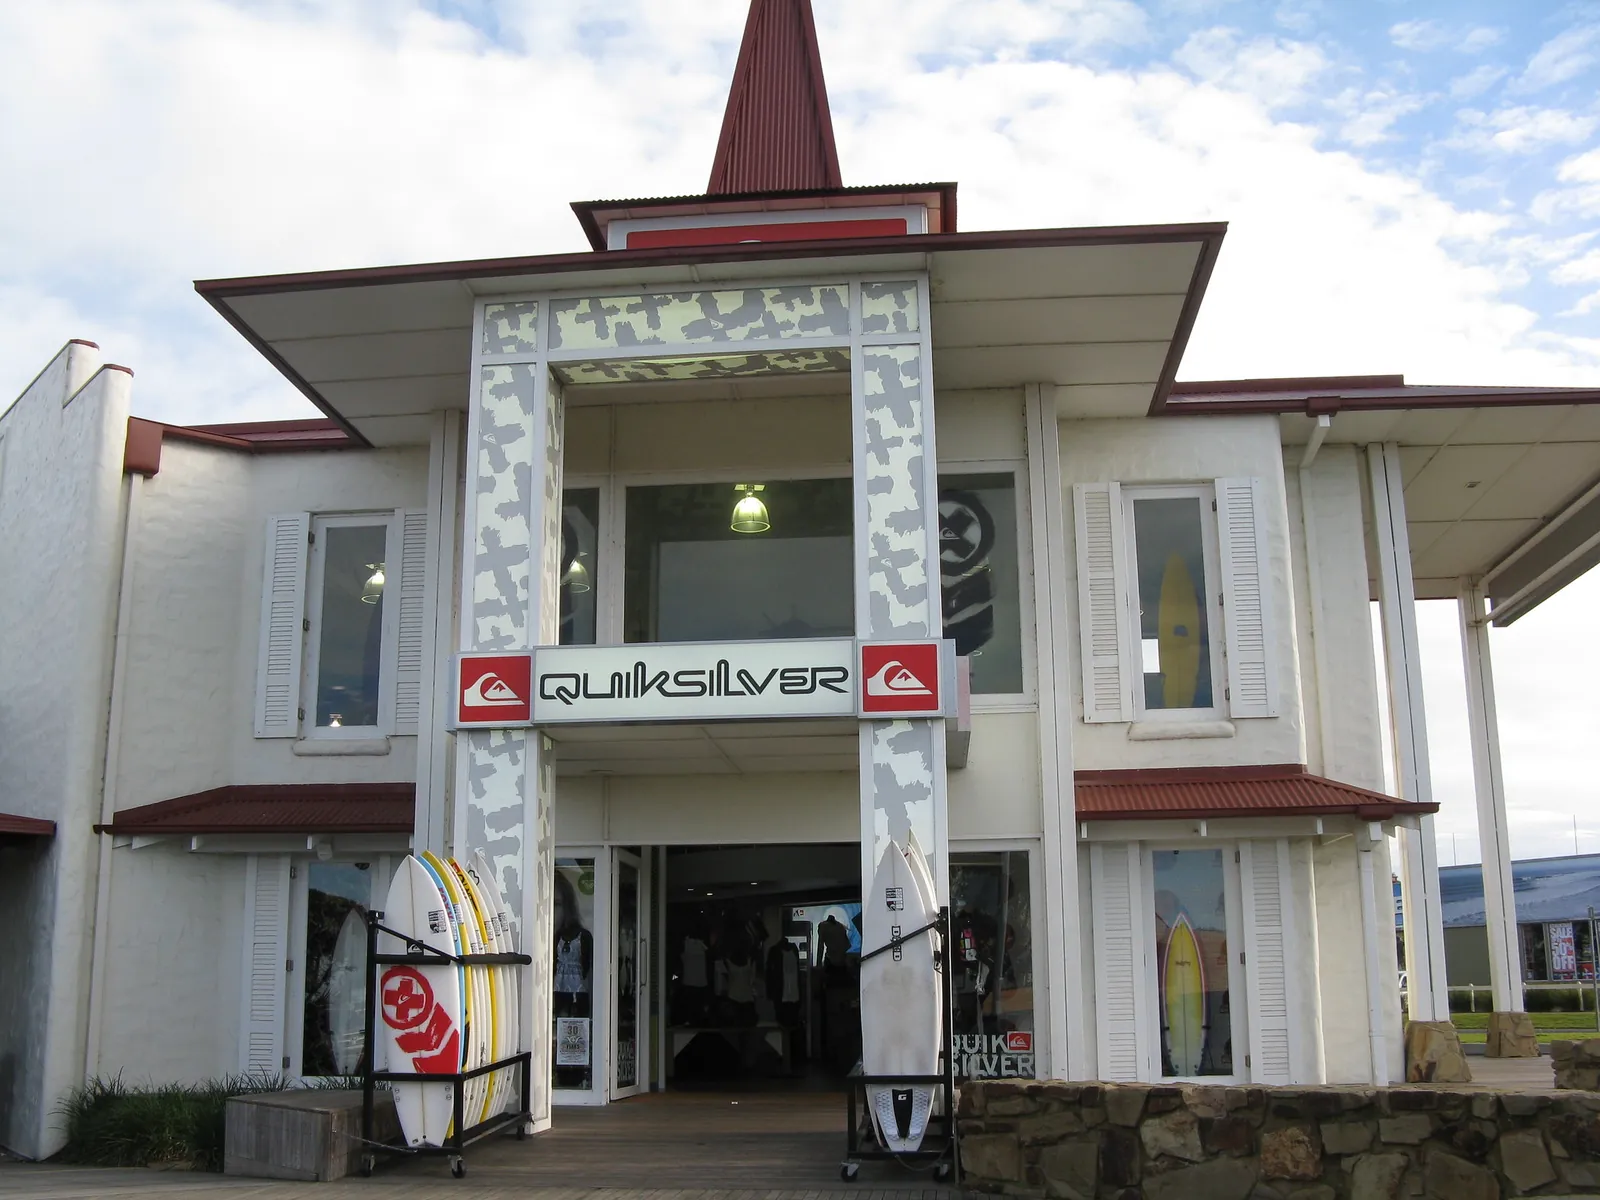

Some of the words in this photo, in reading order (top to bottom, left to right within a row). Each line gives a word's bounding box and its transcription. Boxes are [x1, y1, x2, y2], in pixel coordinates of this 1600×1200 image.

[539, 658, 850, 706] QUIKSILVER
[1550, 927, 1573, 937] SALE
[1552, 956, 1576, 970] OFF
